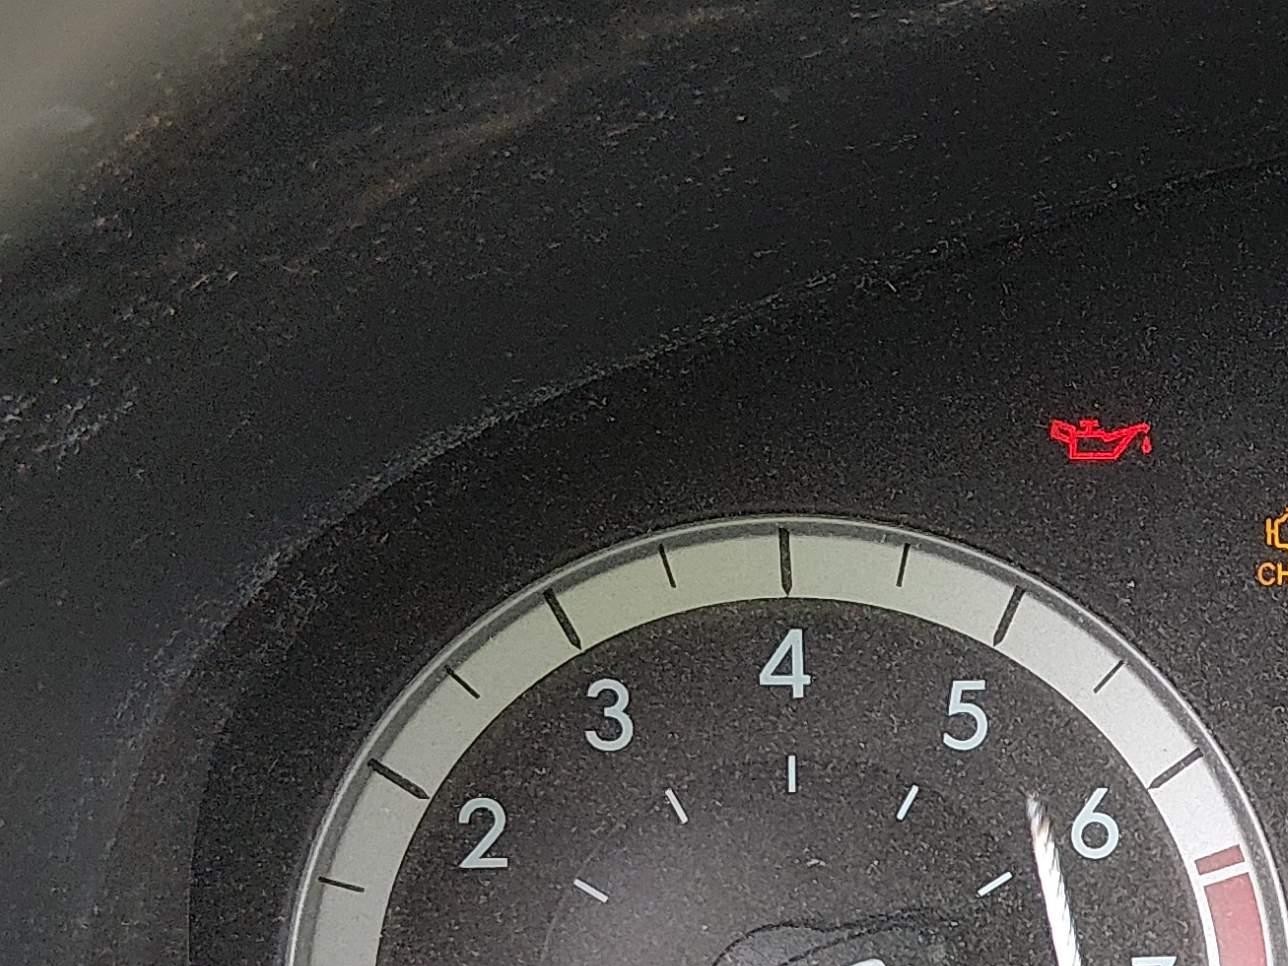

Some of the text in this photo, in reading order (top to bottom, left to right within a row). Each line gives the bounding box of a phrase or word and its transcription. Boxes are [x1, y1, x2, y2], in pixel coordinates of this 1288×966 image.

[759, 628, 812, 698] 4
[584, 678, 634, 751] 3
[942, 679, 989, 751] 5
[457, 797, 509, 869] 2
[1070, 787, 1120, 859] 6
